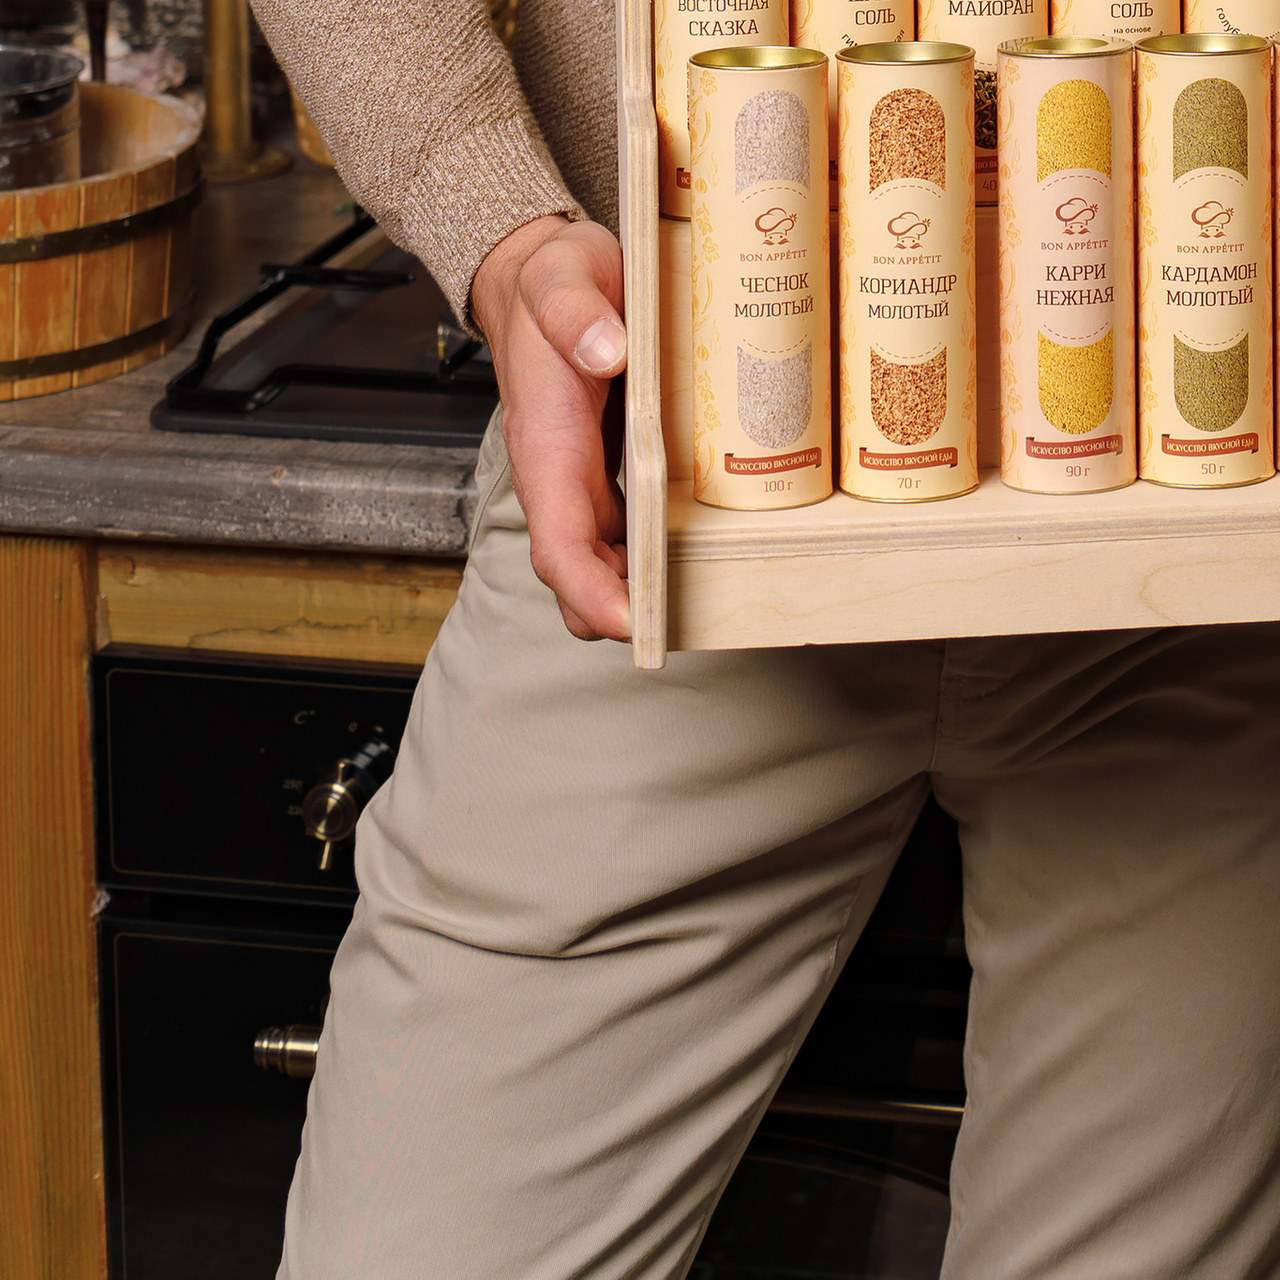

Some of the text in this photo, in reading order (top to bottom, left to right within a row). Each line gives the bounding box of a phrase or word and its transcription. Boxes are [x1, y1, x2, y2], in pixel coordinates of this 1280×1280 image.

[1110, 1, 1154, 19] СОЛЬ
[855, 8, 896, 26] СОЛЬ
[688, 18, 759, 37] СКАЗКА
[1124, 26, 1152, 34] основе
[1040, 241, 1064, 251] BON
[1176, 245, 1199, 254] BON
[739, 253, 763, 263] BON
[873, 255, 895, 265] BON
[1045, 263, 1106, 282] КАРРИ
[1161, 262, 1257, 285] КАРДАМОН
[740, 272, 809, 293] ЧЕСНОК
[859, 274, 957, 296] КОРИАНДР
[1036, 286, 1114, 306] НЕЖНАЯ
[1166, 285, 1254, 307] МОЛОТЫЙ
[734, 297, 814, 318] МОЛОТЫЙ
[868, 299, 949, 320] МОЛОТЫЙ
[1031, 445, 1072, 455] ИСКУССТВО
[1166, 442, 1207, 452] ИСКУССТВО
[730, 460, 772, 471] ИСКУССТВО
[864, 455, 904, 466] ИСКУССТВО
[1065, 465, 1082, 478] 90
[1201, 462, 1217, 475] 50
[764, 479, 785, 493] 100
[897, 477, 913, 489] 70
